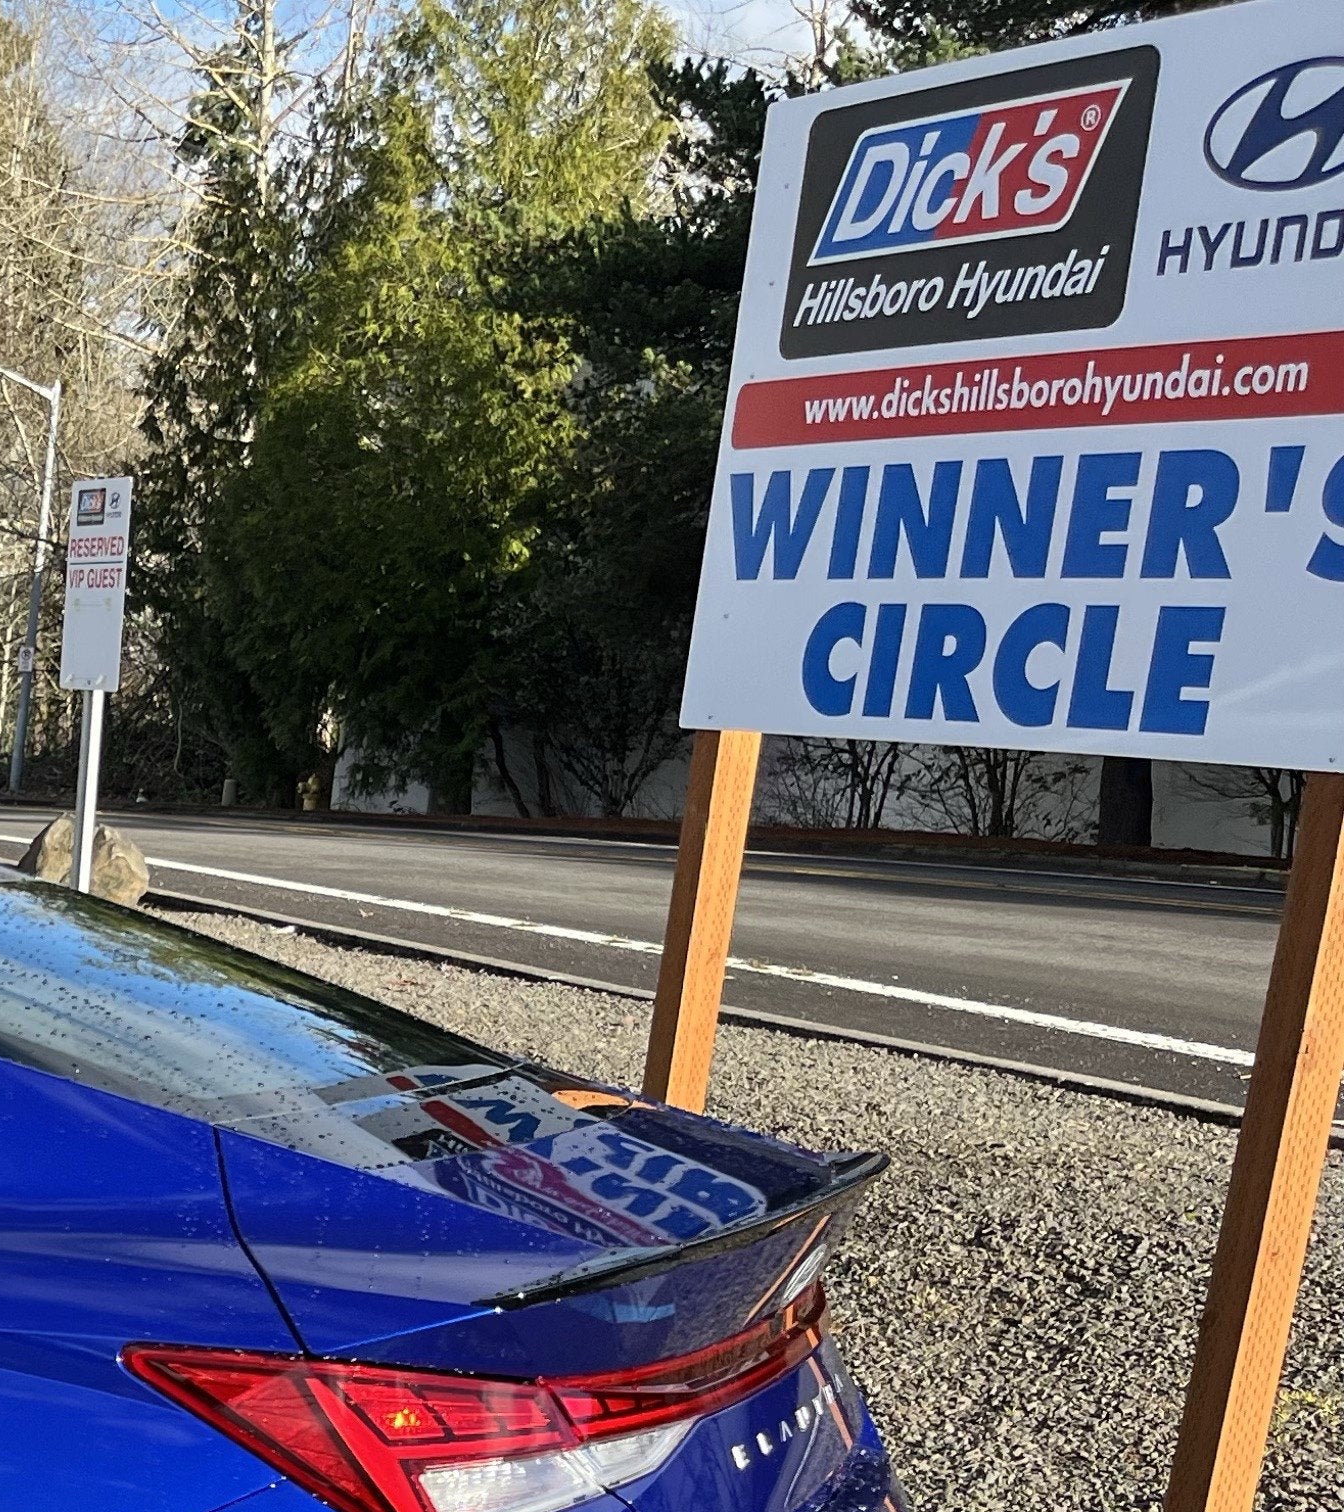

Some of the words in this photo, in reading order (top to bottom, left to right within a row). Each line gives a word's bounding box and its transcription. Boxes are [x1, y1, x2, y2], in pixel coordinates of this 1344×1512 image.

[831, 108, 1081, 243] Dick's
[792, 274, 945, 327] Hillsboro
[947, 245, 1110, 319] Hyundai
[805, 354, 1309, 425] www.dickshillsborohyundai.com
[69, 536, 124, 558] RESERVED
[69, 569, 85, 588] VIP
[87, 568, 122, 588] GUEST
[802, 602, 1226, 735] CIRCLE
